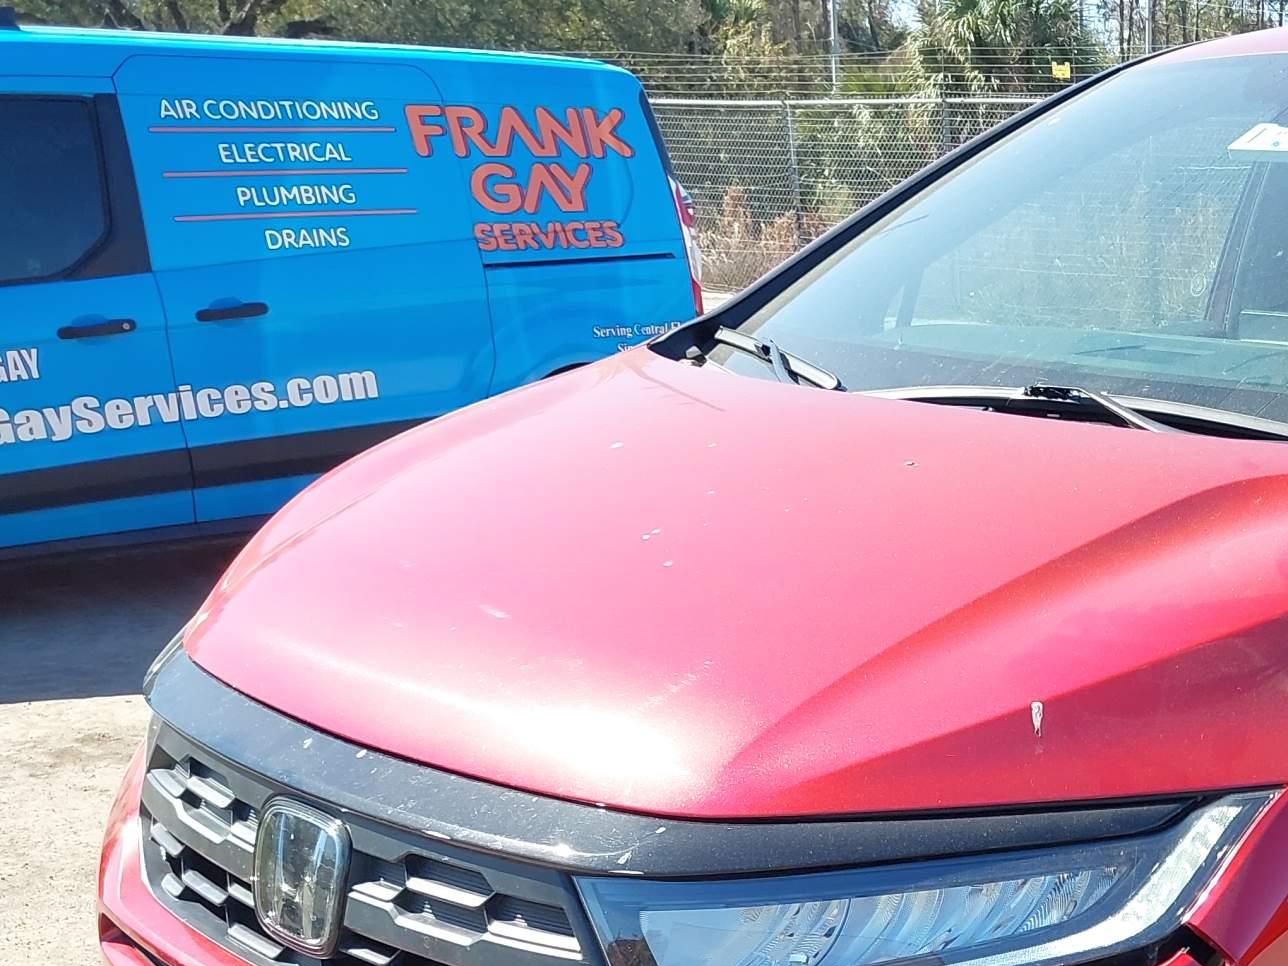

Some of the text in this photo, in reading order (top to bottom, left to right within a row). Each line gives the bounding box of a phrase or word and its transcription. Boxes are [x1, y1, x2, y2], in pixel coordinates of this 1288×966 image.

[160, 99, 379, 120] AIR CONDITIONING
[404, 104, 635, 158] FRANK
[218, 142, 352, 163] ELECTRICAL
[236, 184, 356, 206] PLUMBING
[471, 162, 592, 214] GAY
[264, 227, 350, 250] DRAINS
[473, 221, 624, 251] SERVICES
[593, 324, 632, 338] Serving
[633, 322, 668, 336] Central
